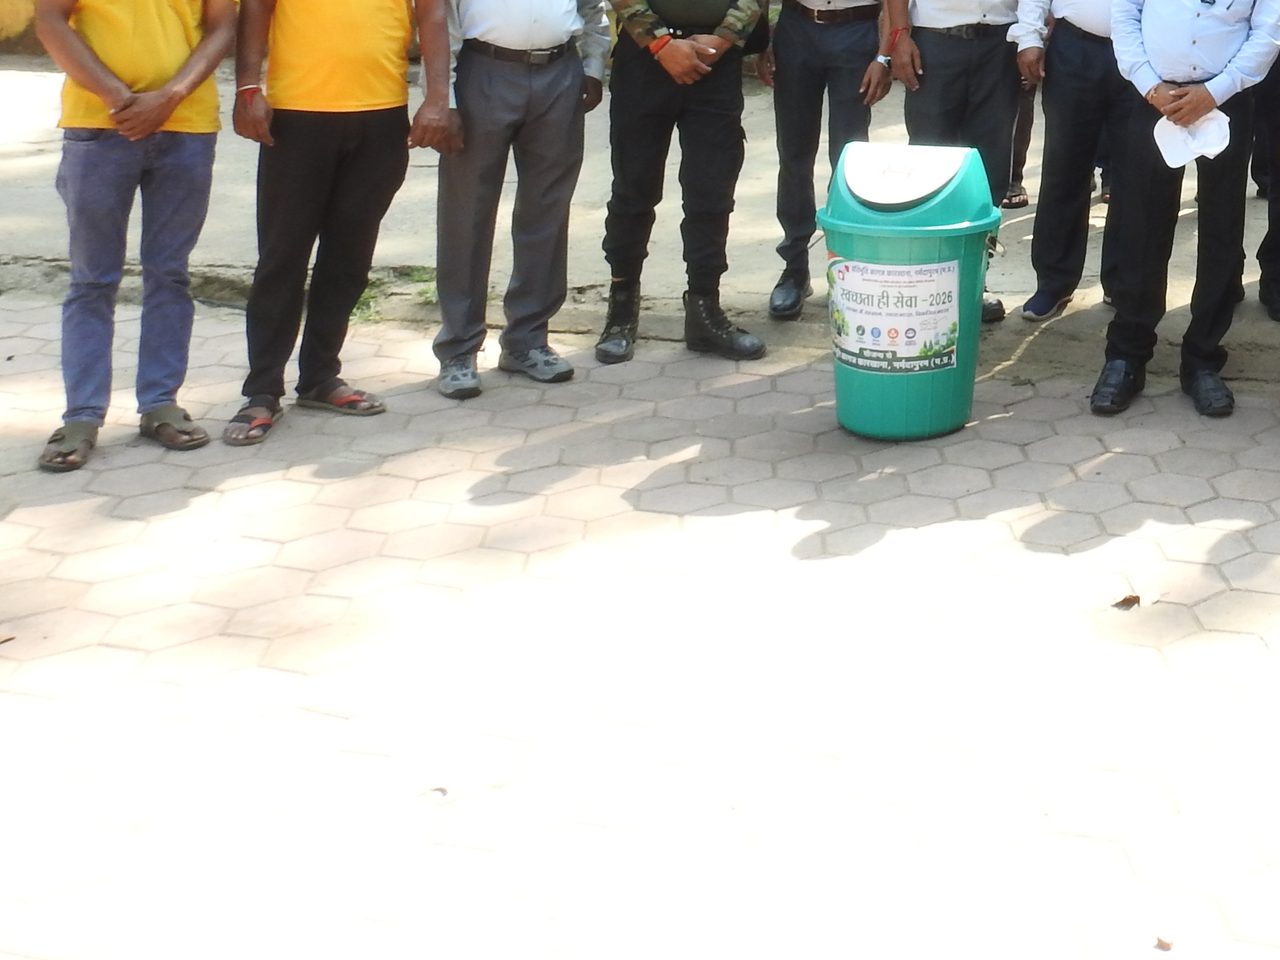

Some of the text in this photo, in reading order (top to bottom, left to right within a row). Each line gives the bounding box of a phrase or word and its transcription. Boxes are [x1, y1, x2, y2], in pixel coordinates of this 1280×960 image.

[840, 287, 875, 307] स्वच्छता
[877, 289, 889, 309] ही
[893, 291, 918, 309] सेवा
